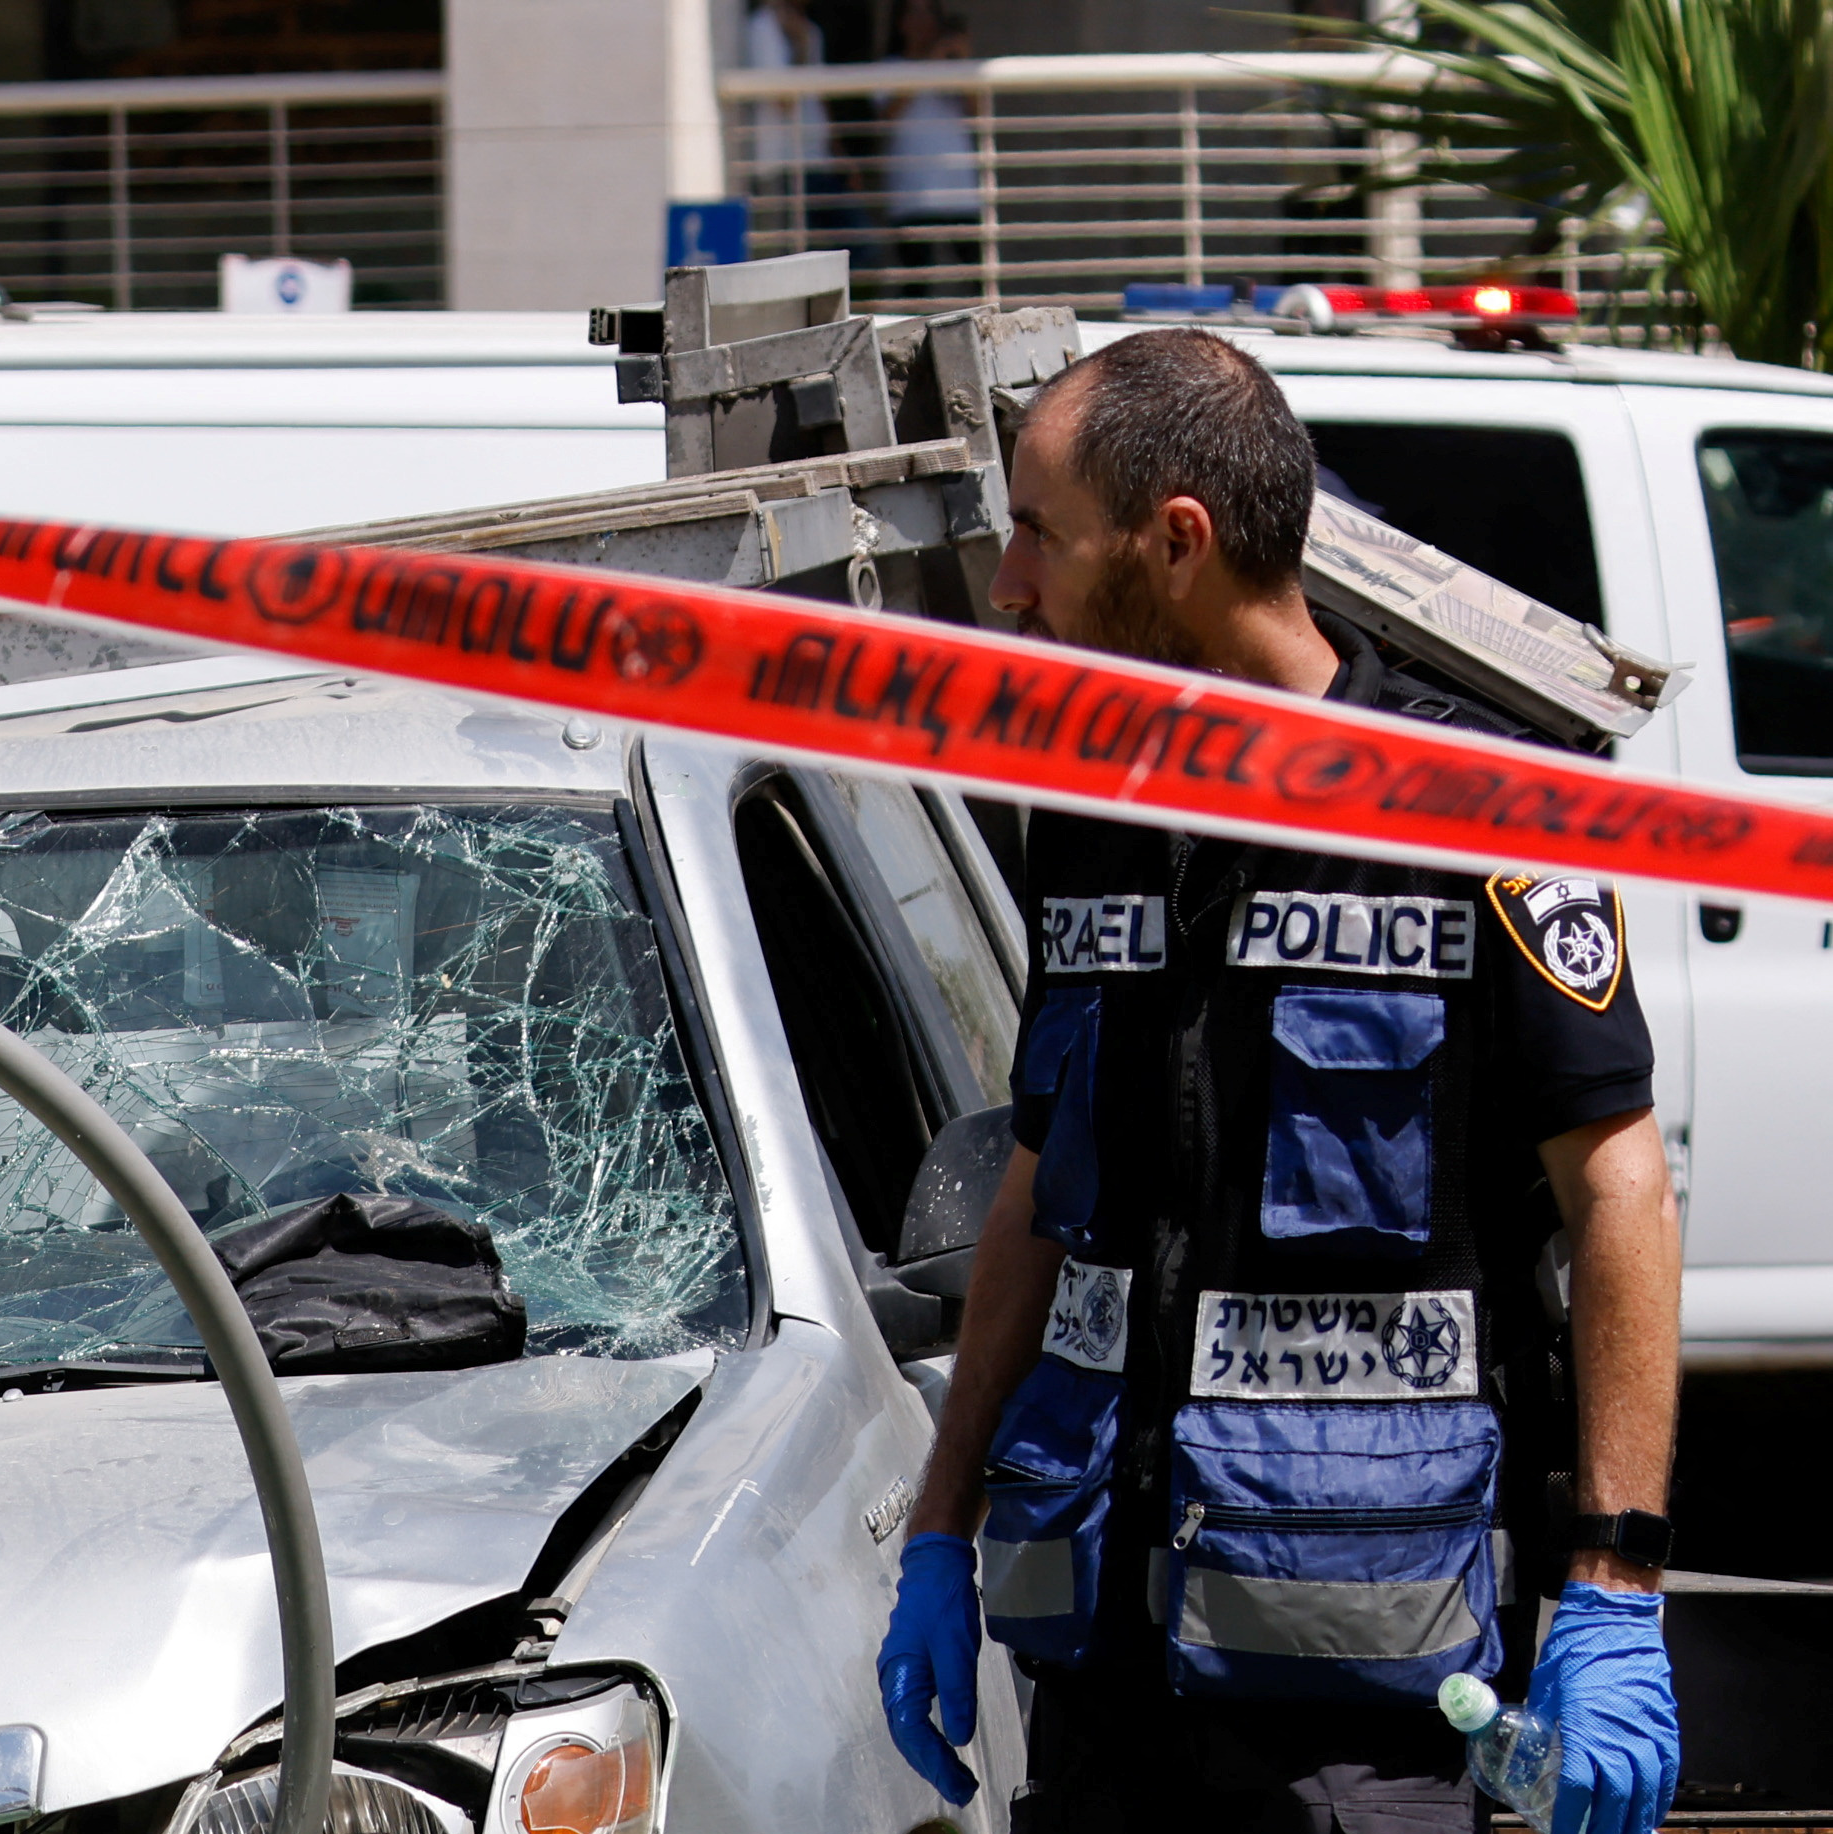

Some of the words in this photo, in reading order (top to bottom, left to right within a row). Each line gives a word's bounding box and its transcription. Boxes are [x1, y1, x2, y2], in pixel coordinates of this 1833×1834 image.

[1042, 904, 1163, 965] SRAEL
[1238, 901, 1467, 971] POLICE
[1214, 1297, 1377, 1333] משטרת
[1210, 1339, 1376, 1386] ישראל
